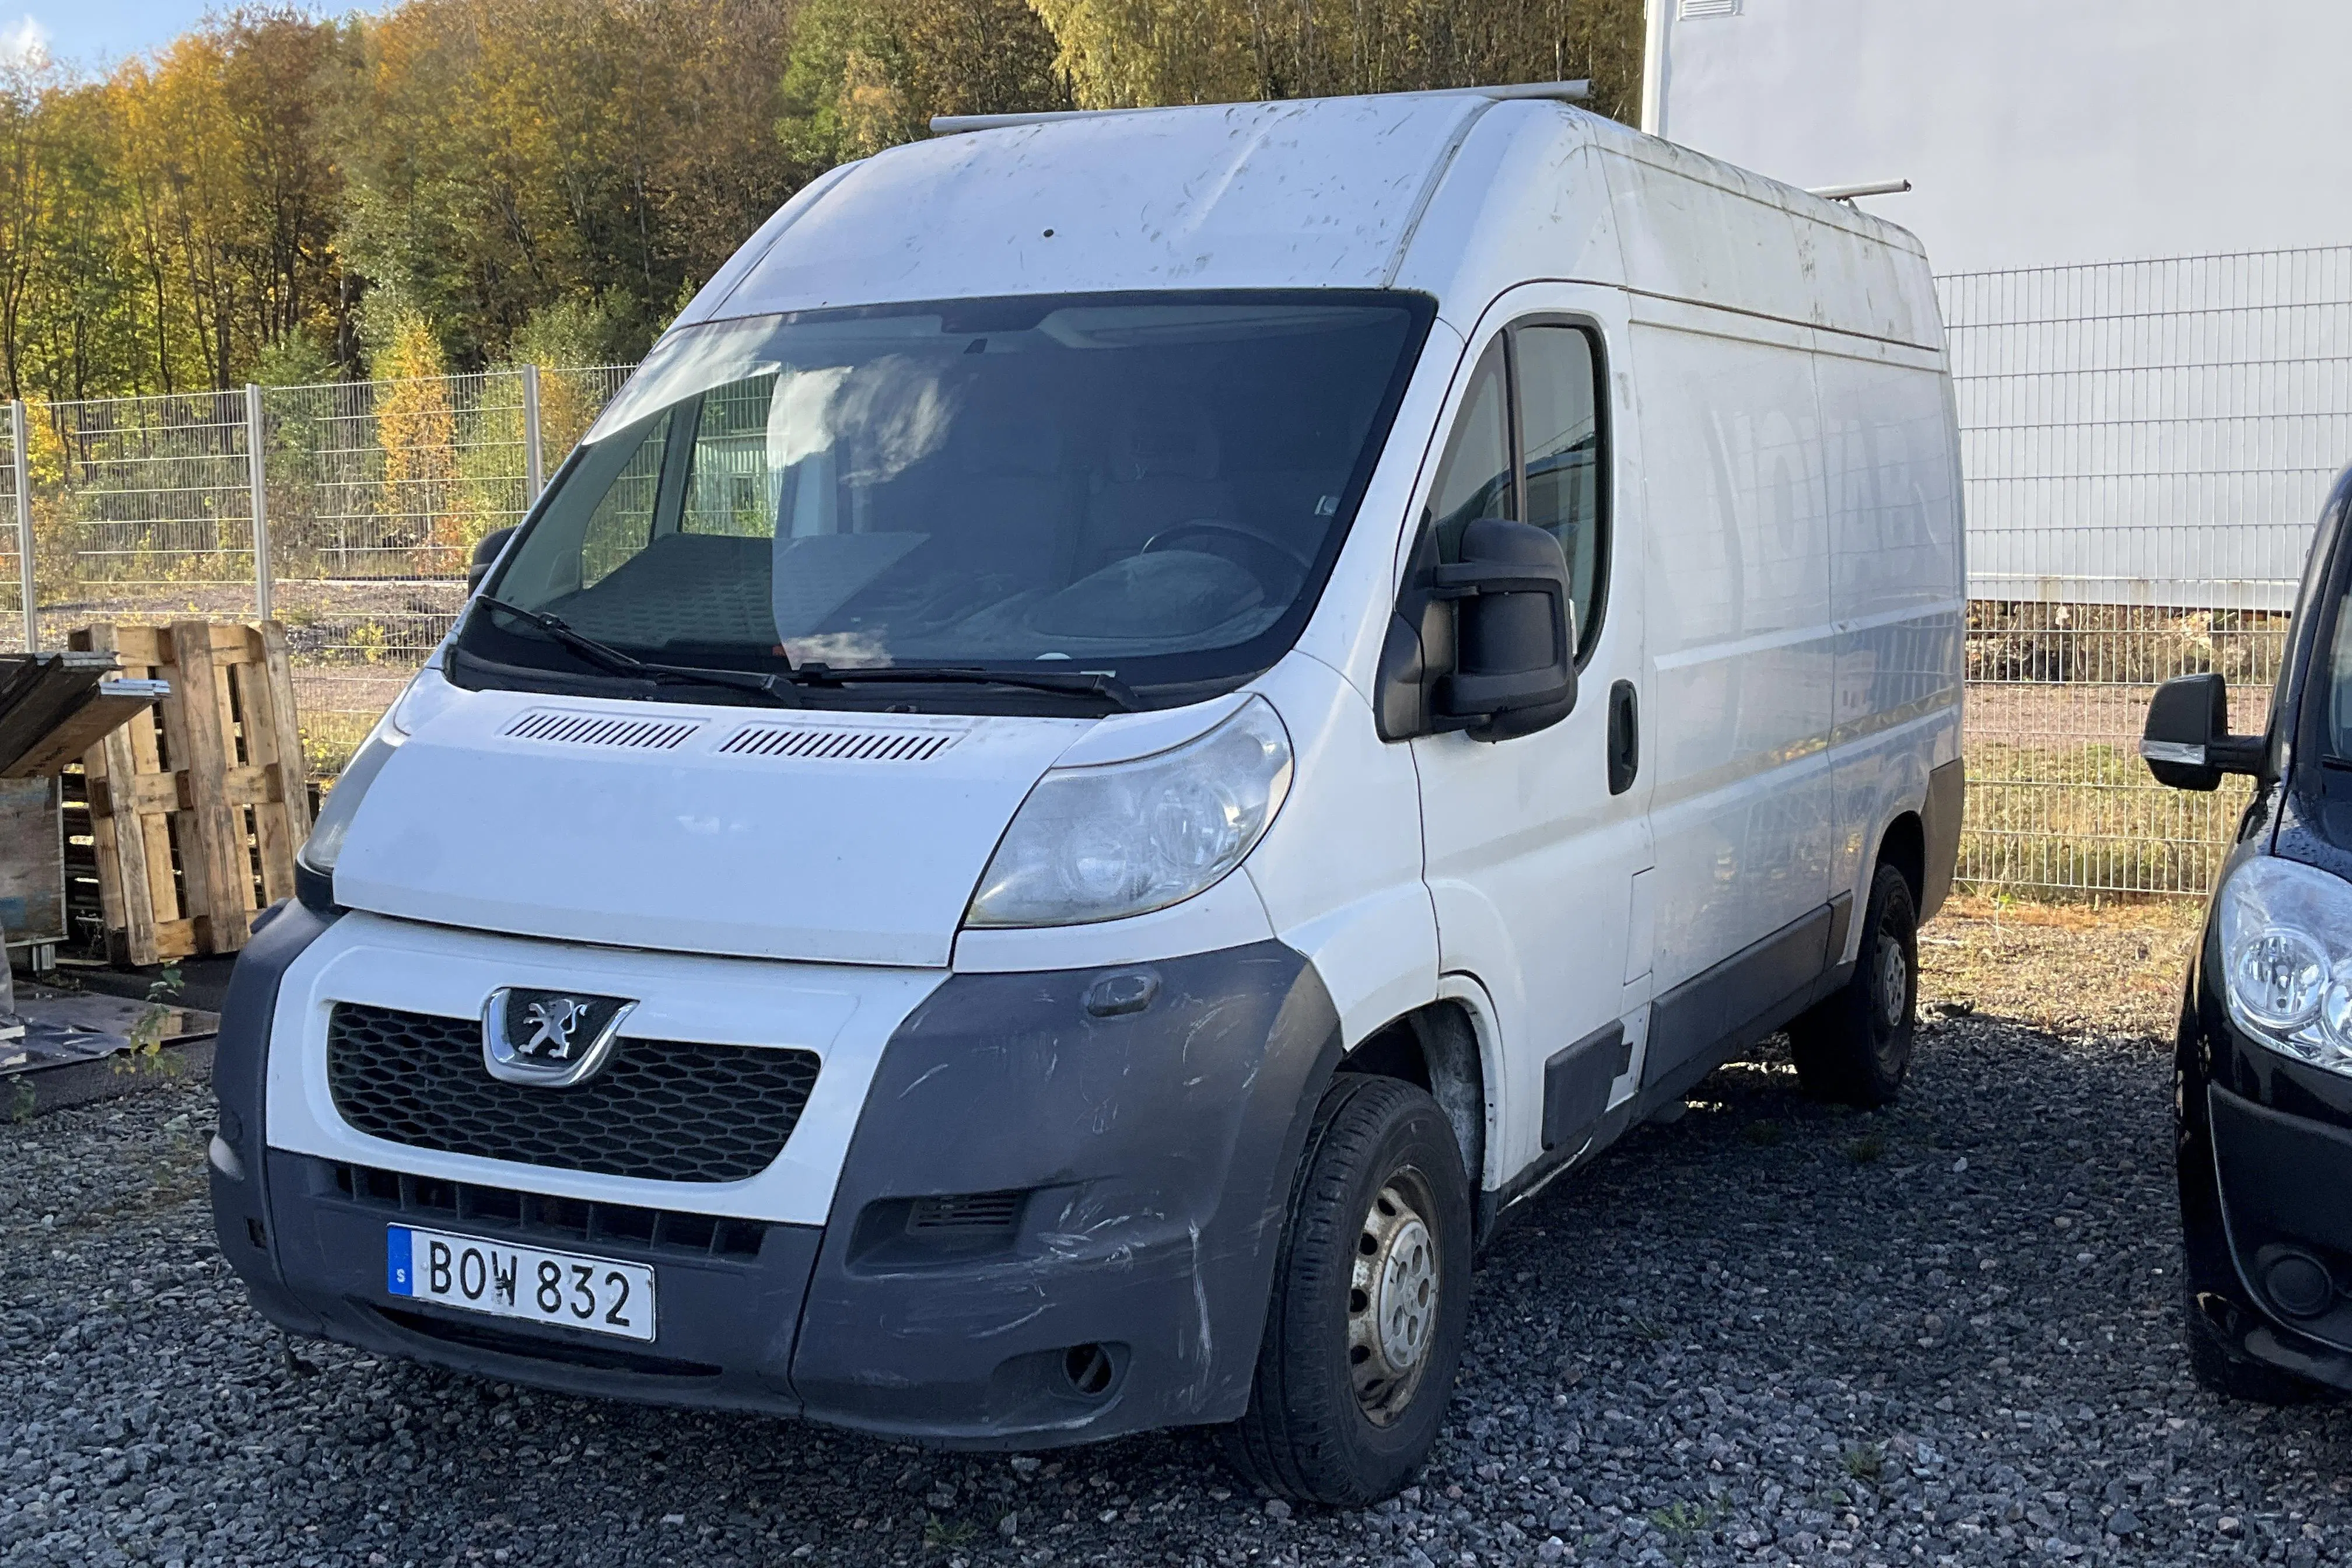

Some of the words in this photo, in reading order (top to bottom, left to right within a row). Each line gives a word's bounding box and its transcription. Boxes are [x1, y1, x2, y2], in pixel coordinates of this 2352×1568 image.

[396, 1268, 406, 1283] S
[429, 1240, 518, 1307] BOW
[536, 1259, 631, 1327] 832
